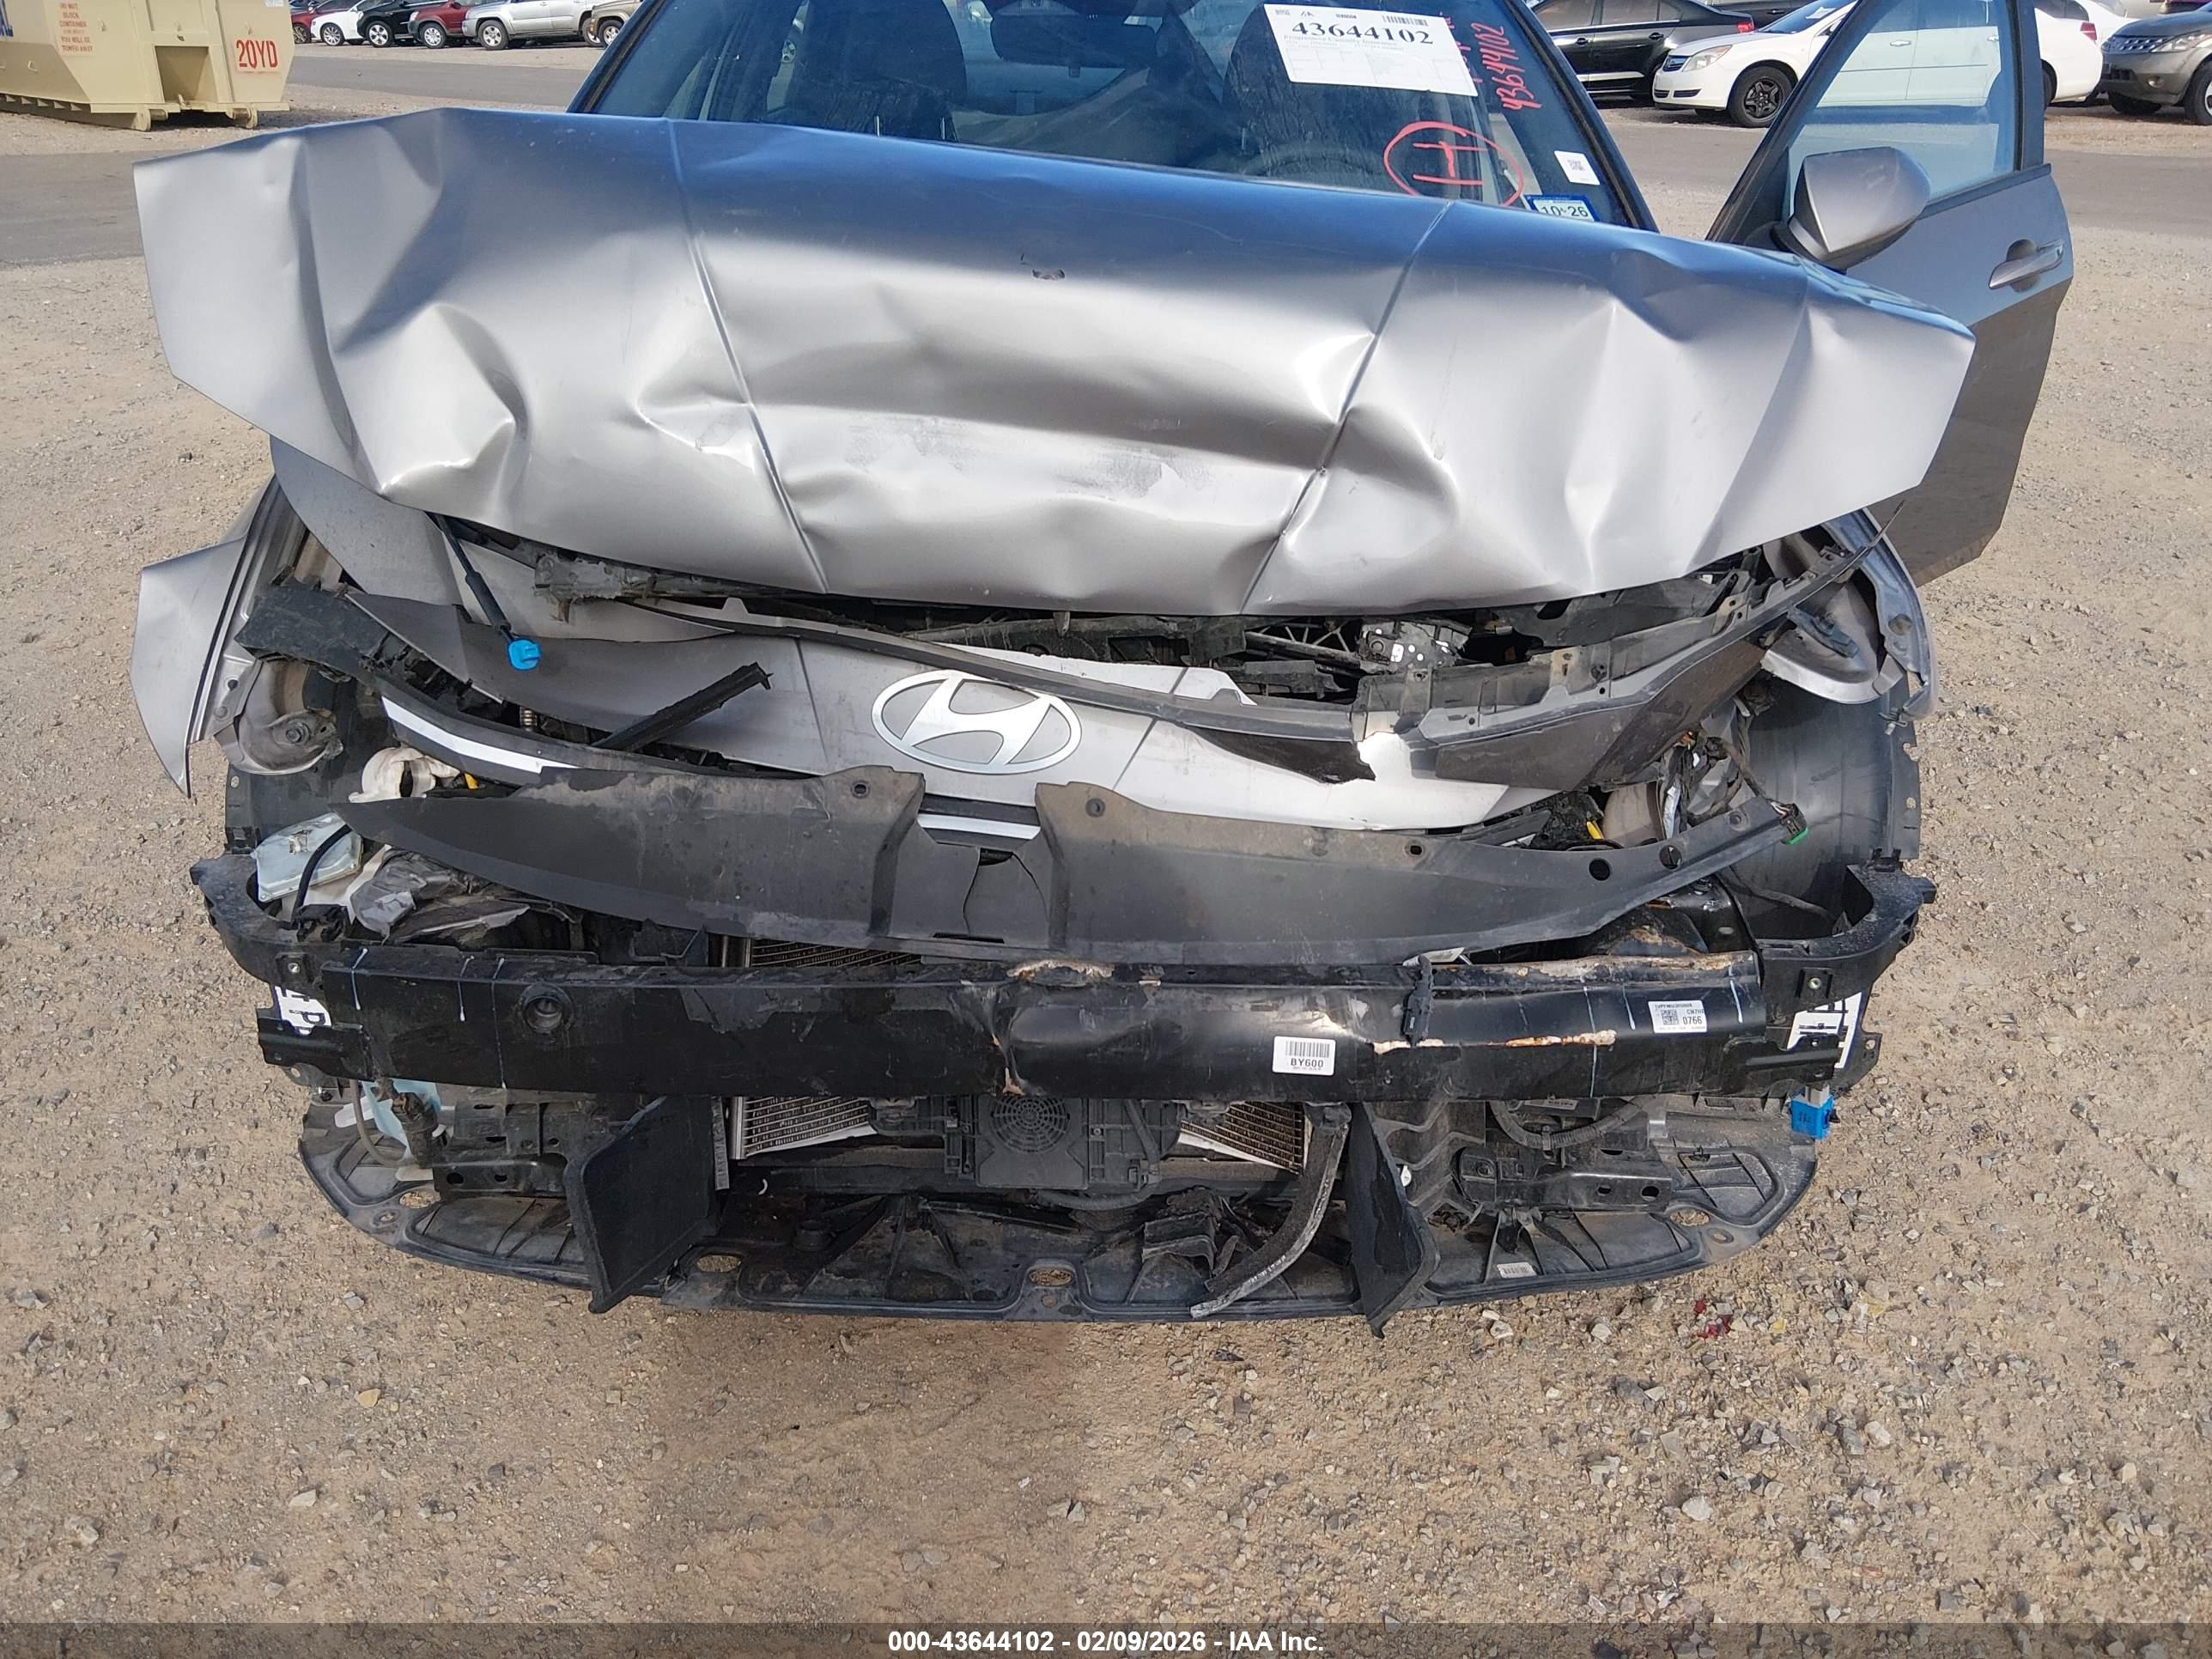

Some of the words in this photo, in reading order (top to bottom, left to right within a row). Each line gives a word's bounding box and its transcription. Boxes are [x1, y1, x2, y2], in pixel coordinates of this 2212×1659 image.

[1292, 21, 1433, 45] 43644102
[236, 40, 278, 69] 20YD
[1471, 22, 1542, 110] 43644102
[1567, 206, 1589, 217] 26
[1682, 1016, 1703, 1025] 0766
[1291, 1058, 1324, 1068] BY600
